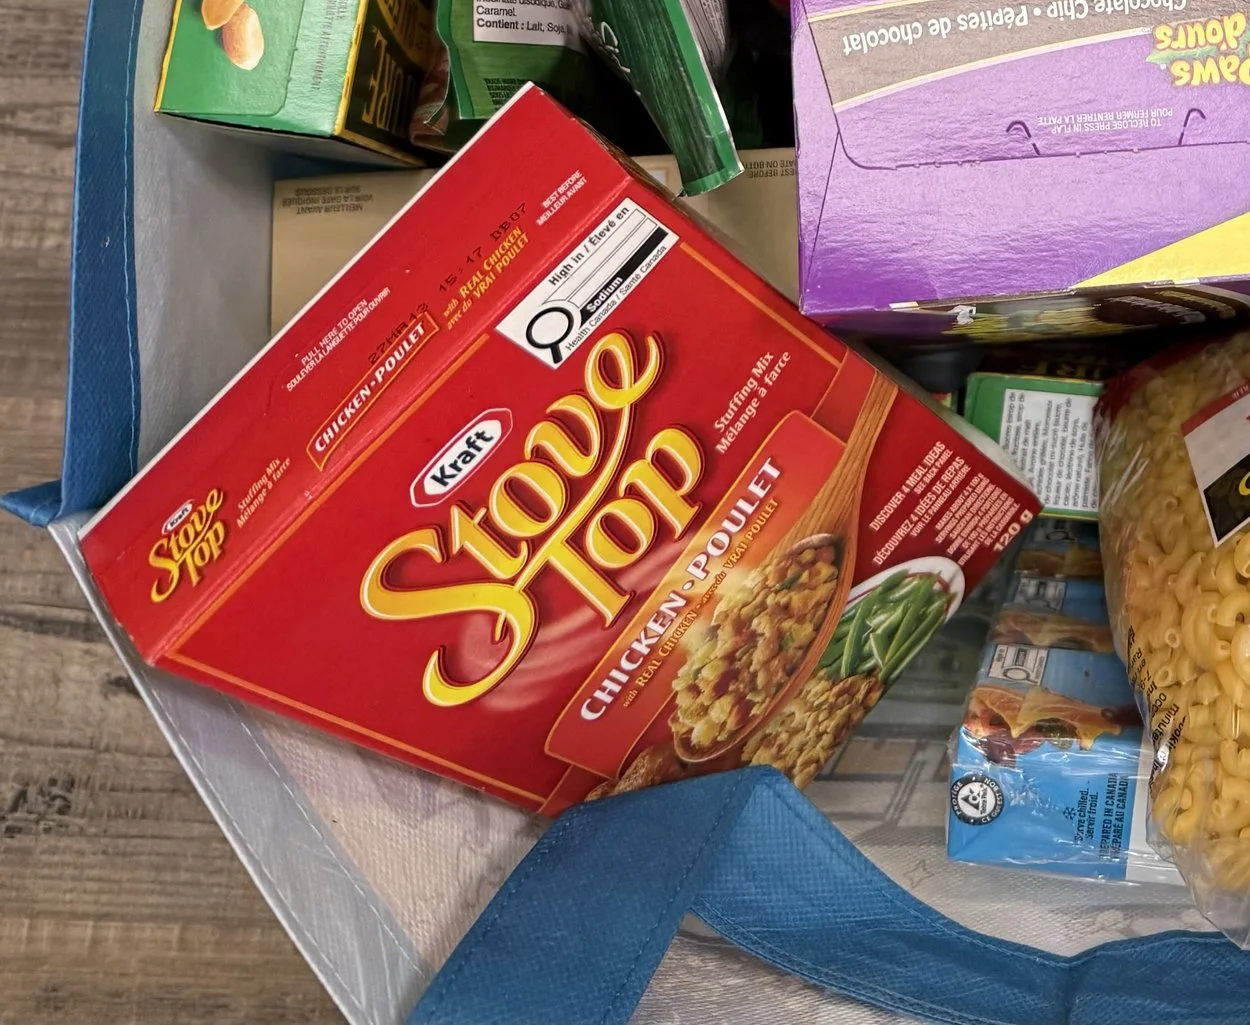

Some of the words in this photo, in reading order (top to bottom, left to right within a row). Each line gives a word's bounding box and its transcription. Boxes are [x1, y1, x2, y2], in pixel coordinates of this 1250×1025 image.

[476, 17, 519, 30] Contient
[842, 21, 922, 54] chocolat
[927, 13, 950, 36] de
[955, 3, 1027, 32] Pépites
[1154, 15, 1244, 50] d'ours
[548, 260, 574, 287] High
[570, 249, 585, 265] in
[587, 217, 616, 246] Élevé
[615, 205, 629, 220] en
[585, 274, 624, 313] Sodium
[712, 375, 758, 433] Stuffing
[715, 395, 760, 454] Mélange
[428, 422, 498, 494] Kraft
[361, 330, 657, 705] Stove
[518, 422, 705, 627] Top
[991, 520, 1022, 555] 120
[1019, 507, 1035, 524] g
[577, 590, 687, 725] CHICKEN
[685, 455, 785, 582] POULET
[1086, 790, 1098, 814] froid.
